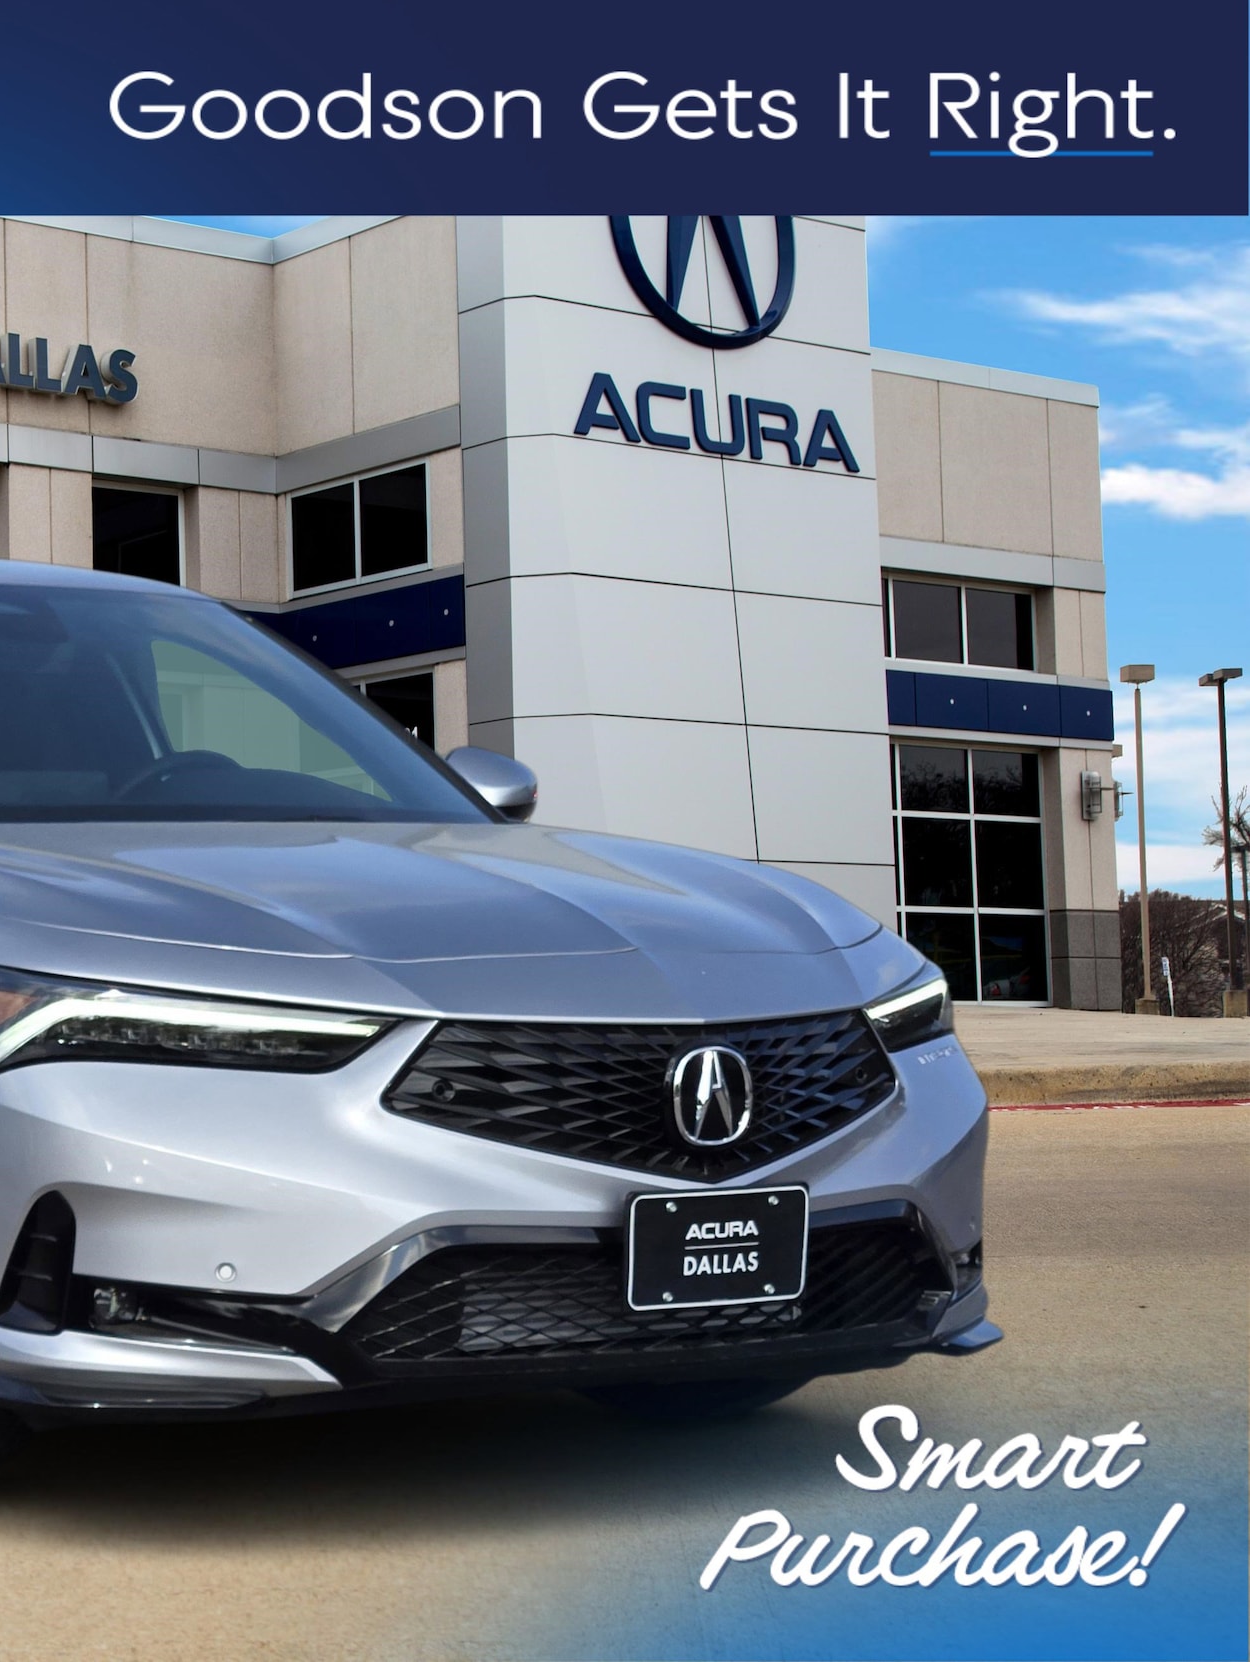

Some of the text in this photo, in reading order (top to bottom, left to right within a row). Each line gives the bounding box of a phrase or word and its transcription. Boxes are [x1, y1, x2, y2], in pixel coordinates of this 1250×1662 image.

[573, 372, 861, 473] ACURA
[685, 1220, 760, 1241] ACURA
[682, 1251, 760, 1277] DALLAS
